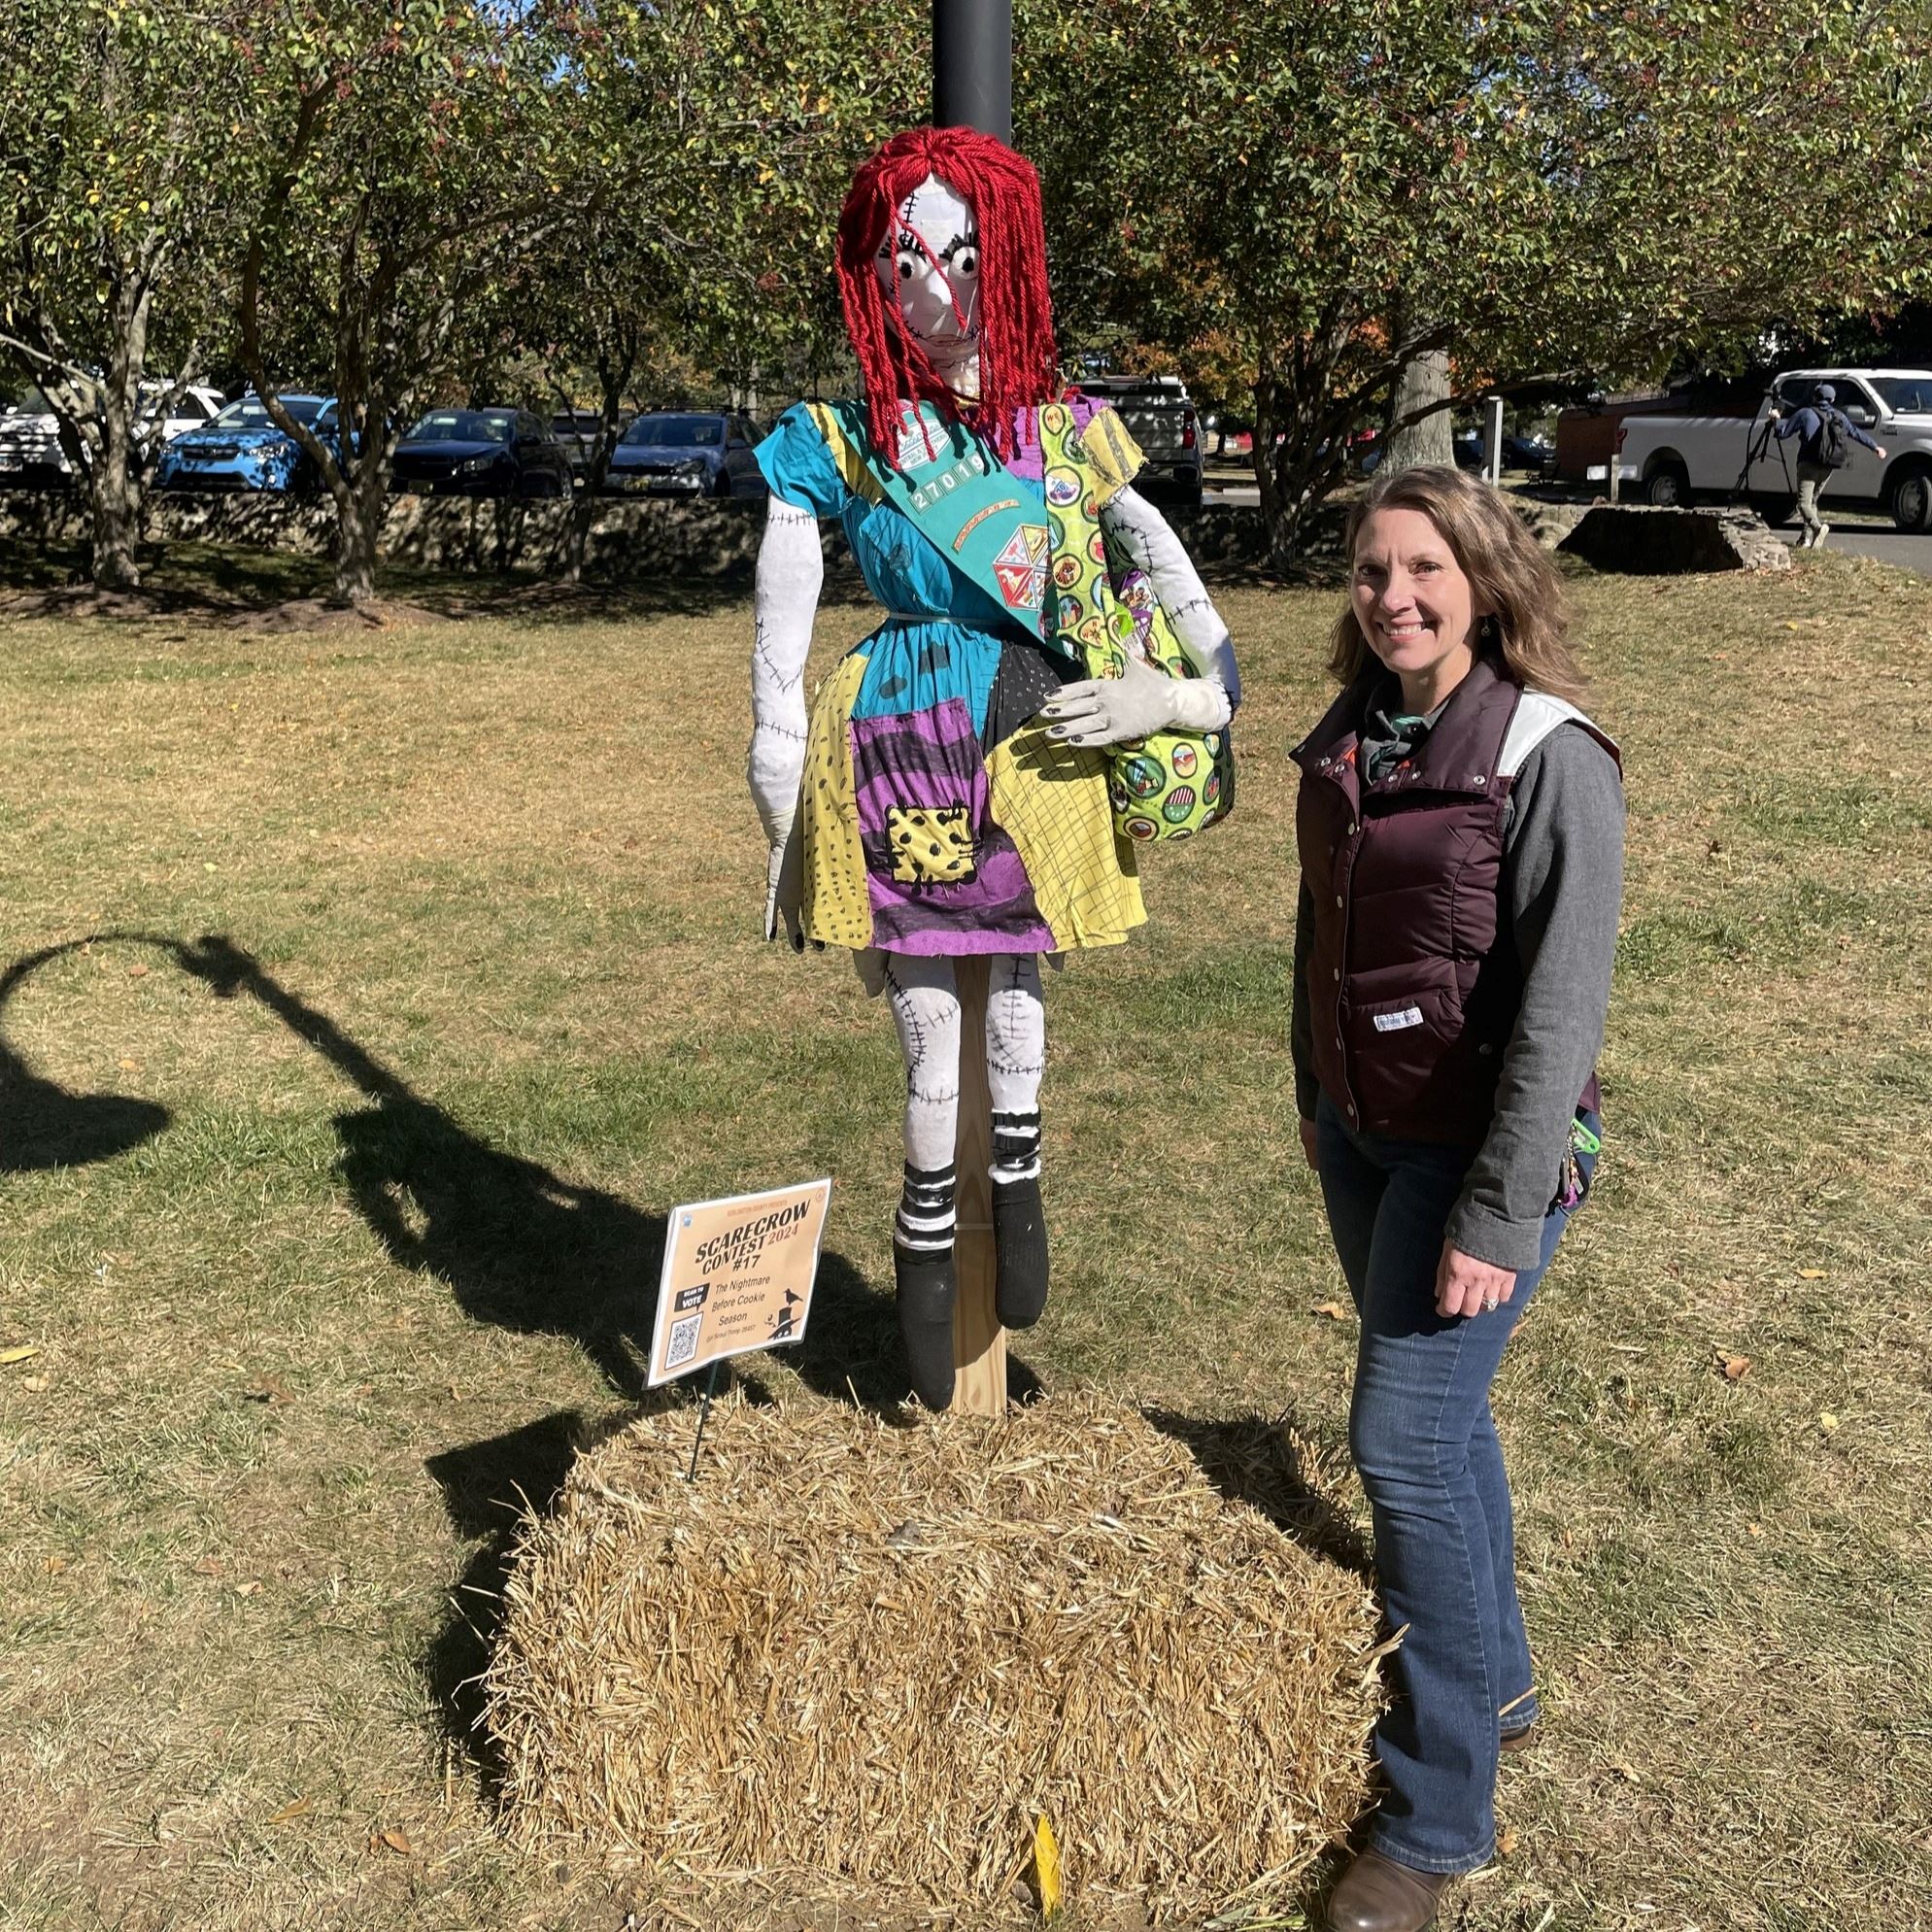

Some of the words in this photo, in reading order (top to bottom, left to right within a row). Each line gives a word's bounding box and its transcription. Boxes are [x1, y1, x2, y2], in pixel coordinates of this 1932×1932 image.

[912, 457, 985, 509] 27019
[695, 1199, 811, 1265] SCARECROW
[702, 1236, 769, 1275] CONTEST
[767, 1223, 798, 1246] 2024
[732, 1254, 762, 1272] #17
[715, 1283, 729, 1294] The
[729, 1274, 771, 1292] Nightmare
[682, 1294, 702, 1308] VOTE
[711, 1299, 736, 1312] Before
[737, 1292, 765, 1305] Cookie
[718, 1312, 748, 1326] Season
